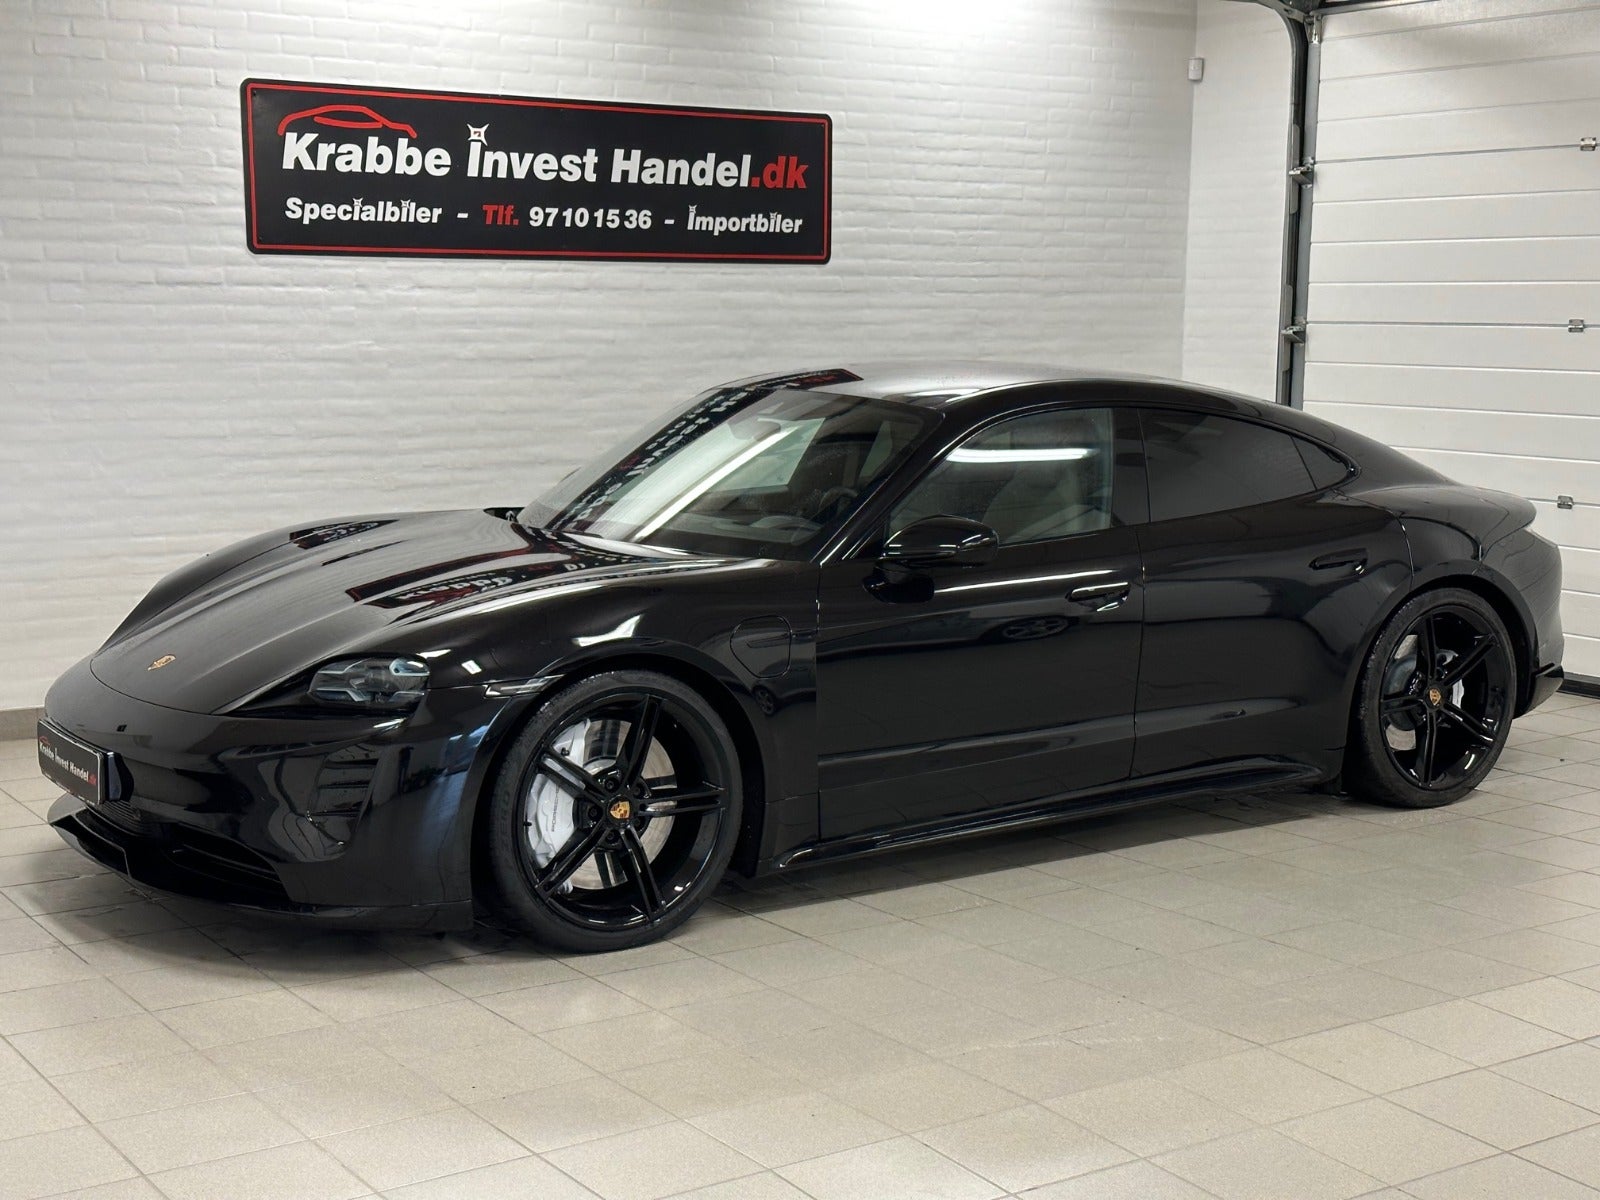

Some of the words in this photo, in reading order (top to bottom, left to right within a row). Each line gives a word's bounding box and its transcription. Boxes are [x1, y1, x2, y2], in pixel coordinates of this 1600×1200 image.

[282, 132, 452, 177] Krabbe
[467, 124, 599, 183] Invest
[610, 148, 809, 189] Handel.dk
[285, 197, 443, 225] Specialbiler
[482, 204, 519, 226] Tlf.
[687, 205, 803, 236] Importbiler
